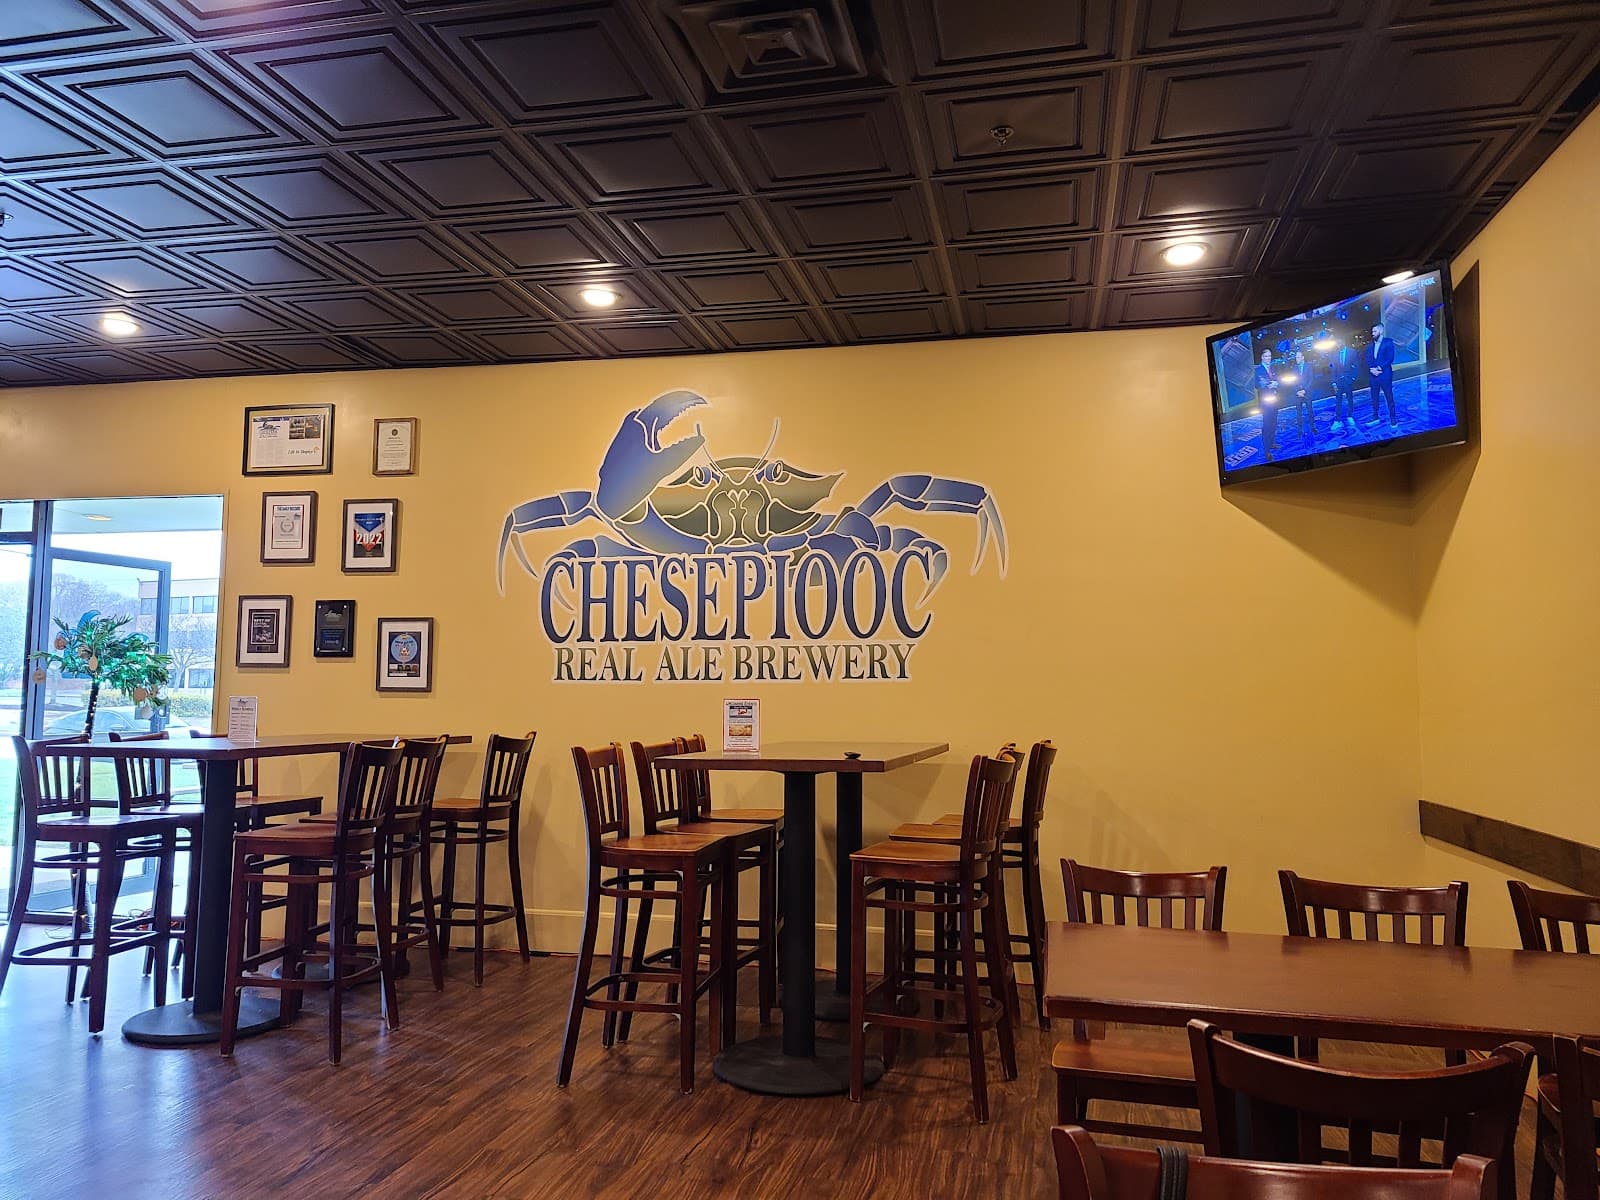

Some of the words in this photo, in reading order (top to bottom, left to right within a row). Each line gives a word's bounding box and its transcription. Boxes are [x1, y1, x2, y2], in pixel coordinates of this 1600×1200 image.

[356, 533, 382, 545] 2022
[541, 549, 932, 642] CHESEPIOOC
[553, 646, 642, 681] REAL
[655, 645, 722, 681] ALE
[733, 643, 916, 681] BREWERY
